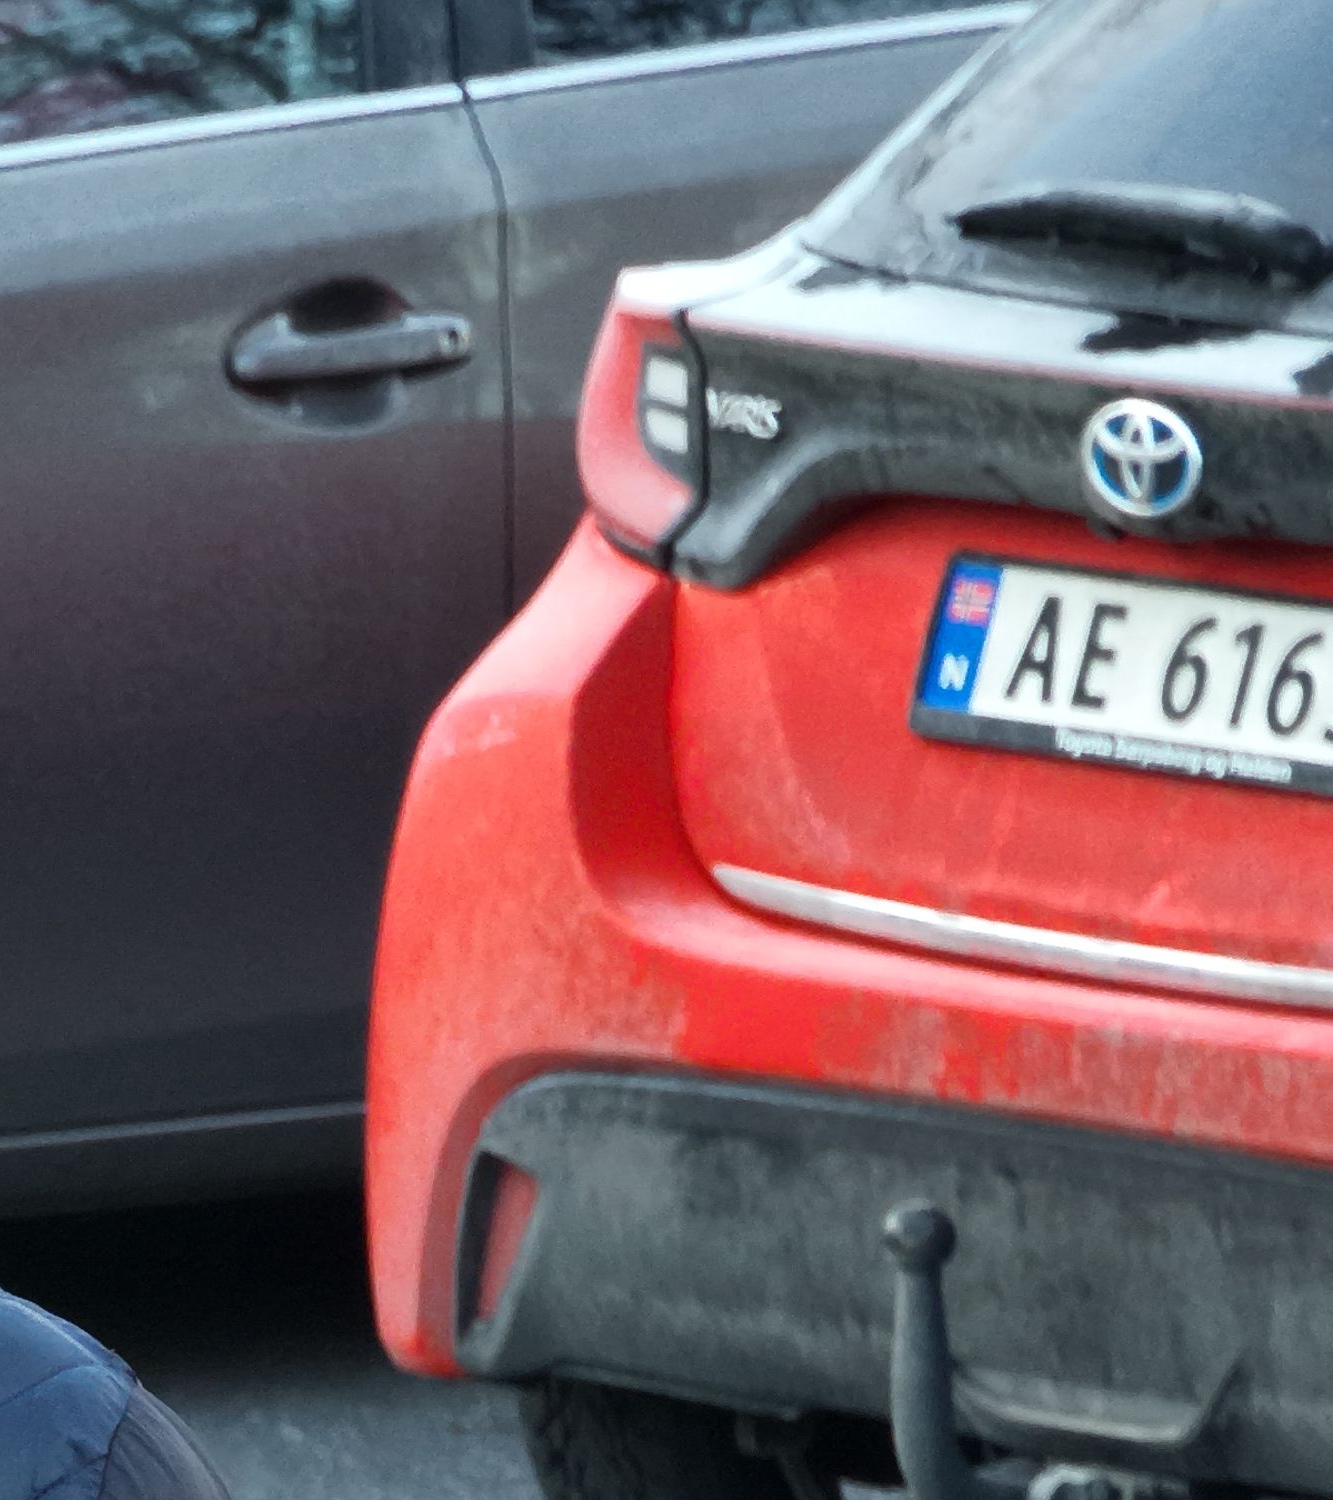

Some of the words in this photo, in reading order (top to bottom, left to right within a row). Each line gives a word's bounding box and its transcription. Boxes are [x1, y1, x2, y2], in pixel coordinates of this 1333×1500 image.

[938, 652, 969, 691] N
[1005, 596, 1129, 709] AE
[1161, 616, 1333, 741] 616
